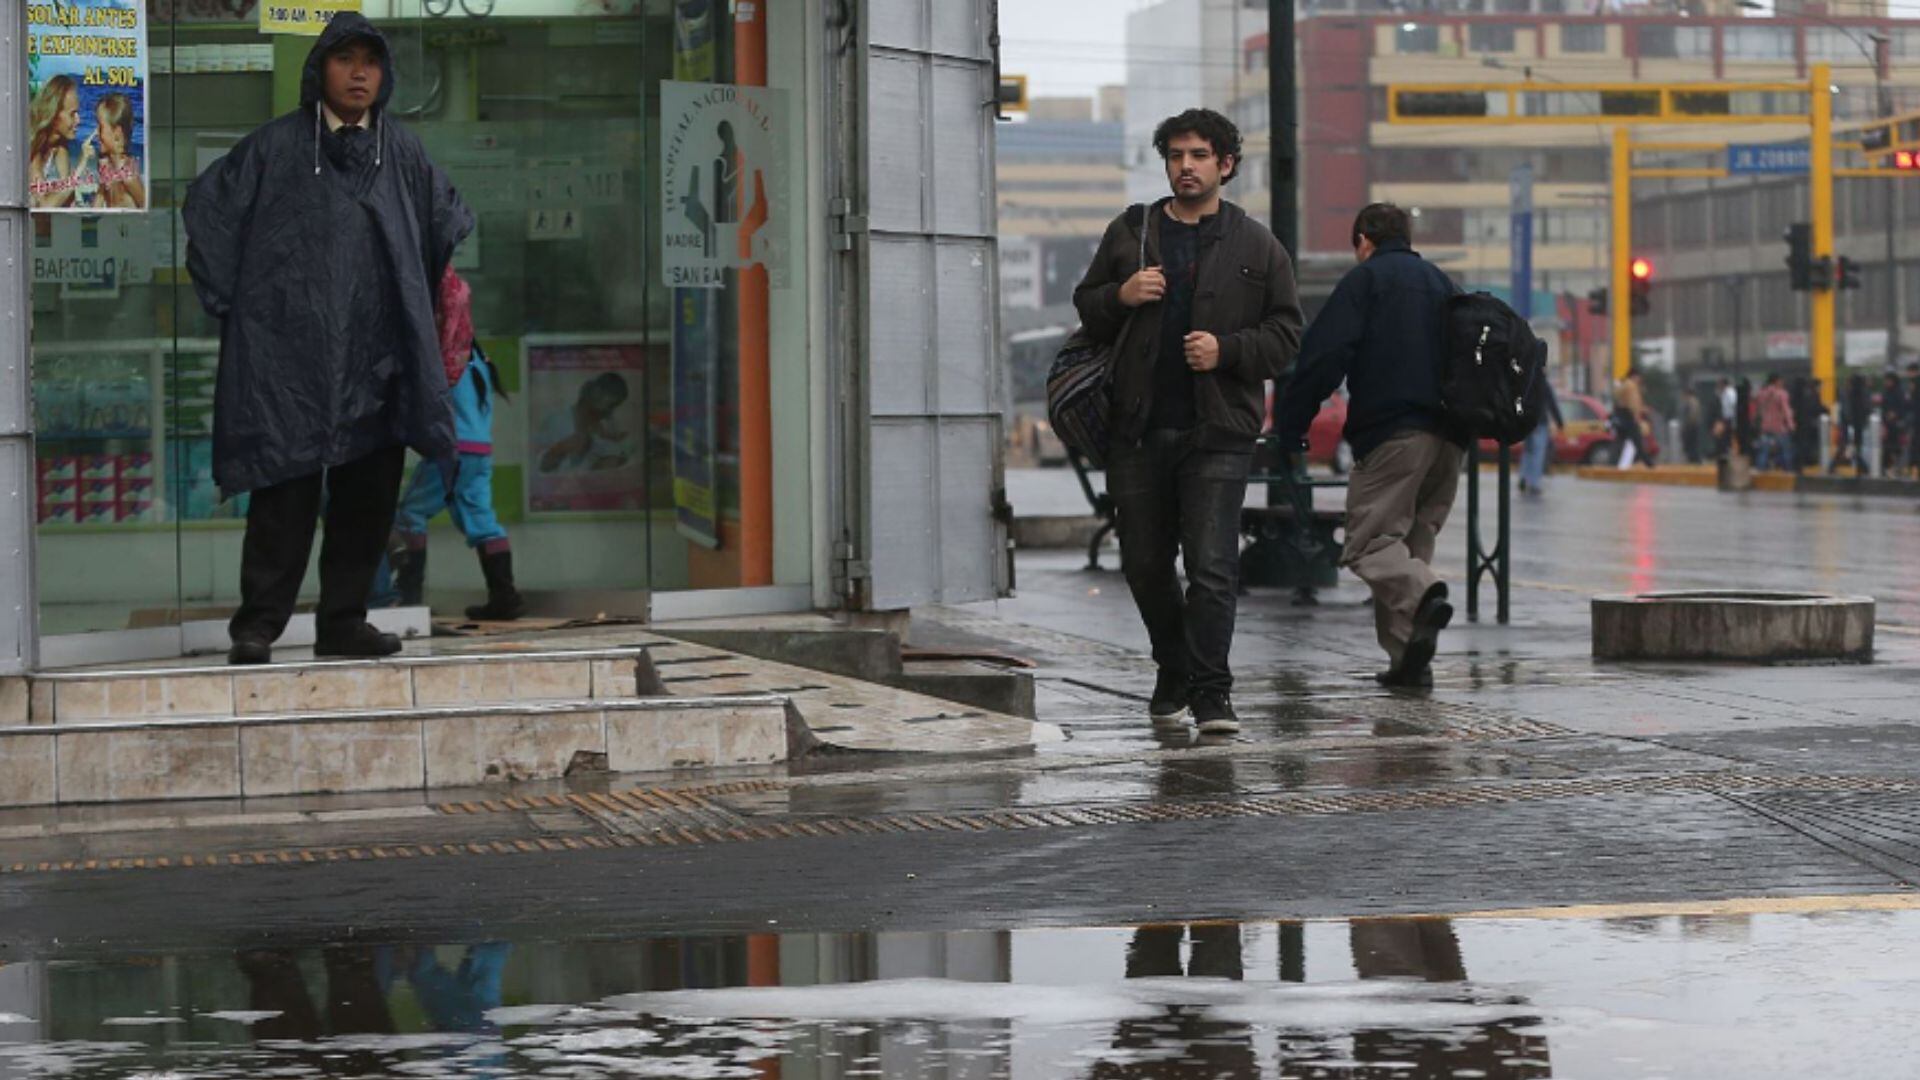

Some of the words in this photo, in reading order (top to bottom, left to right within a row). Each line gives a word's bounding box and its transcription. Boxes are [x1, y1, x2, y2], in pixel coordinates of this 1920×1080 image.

[28, 5, 79, 26] SOLAR
[84, 7, 136, 28] ANTES
[291, 8, 307, 22] AM
[28, 35, 37, 54] E
[41, 36, 136, 57] EXPONERSE
[83, 67, 105, 85] AL
[108, 67, 137, 87] SOL
[665, 111, 694, 213] HOSPITAL
[666, 233, 702, 248] MADRE
